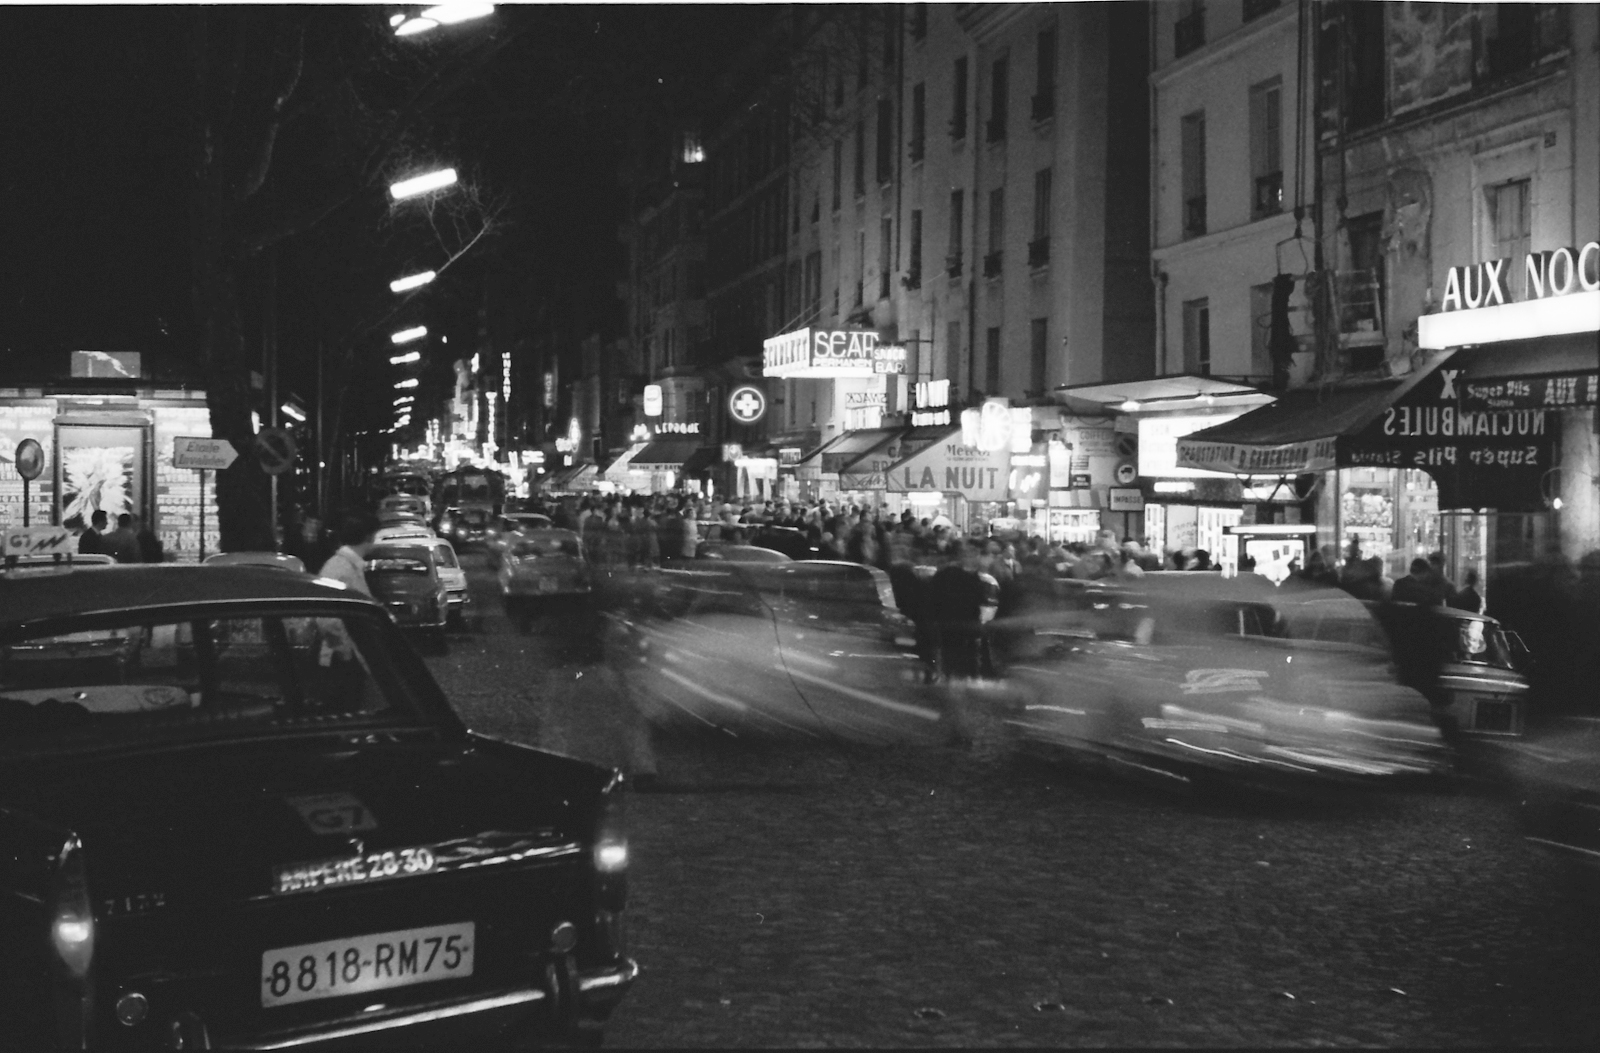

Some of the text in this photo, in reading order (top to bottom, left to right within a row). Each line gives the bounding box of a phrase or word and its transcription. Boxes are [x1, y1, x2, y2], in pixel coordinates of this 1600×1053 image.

[1441, 242, 1600, 312] AUX NOC
[874, 348, 906, 360] SNACK
[876, 361, 904, 373] BAR
[904, 466, 936, 489] LA
[945, 467, 999, 489] NUIT
[1113, 495, 1141, 504] IMPASSE
